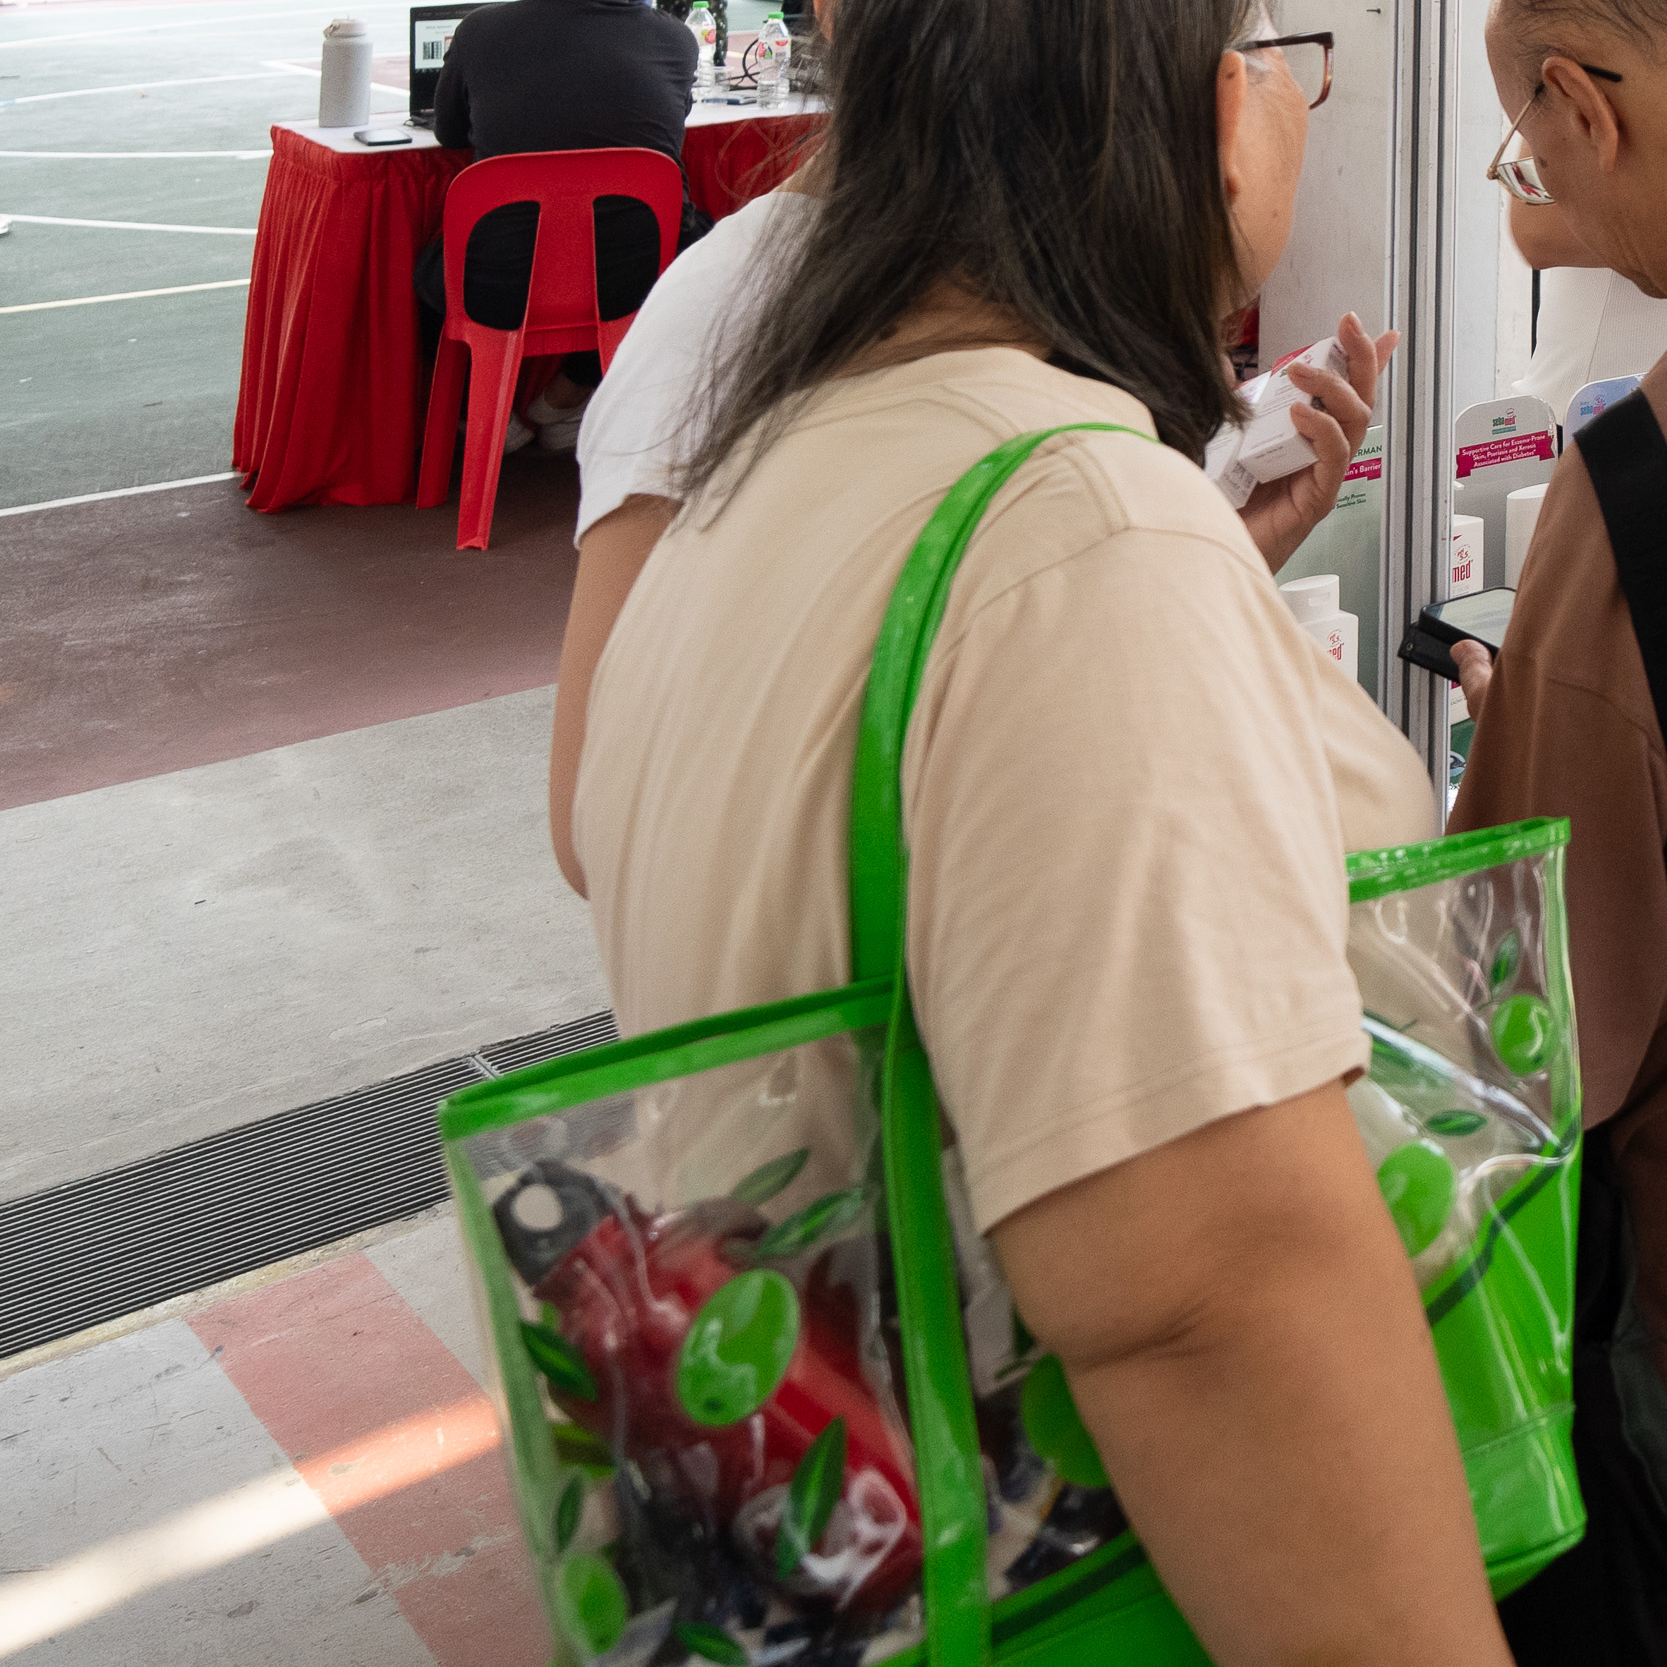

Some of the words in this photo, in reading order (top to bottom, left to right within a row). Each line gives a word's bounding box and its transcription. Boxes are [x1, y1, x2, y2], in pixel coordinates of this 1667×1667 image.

[1462, 446, 1489, 456] Supportive
[1474, 458, 1500, 467] Associated
[1360, 463, 1381, 473] Barrier
